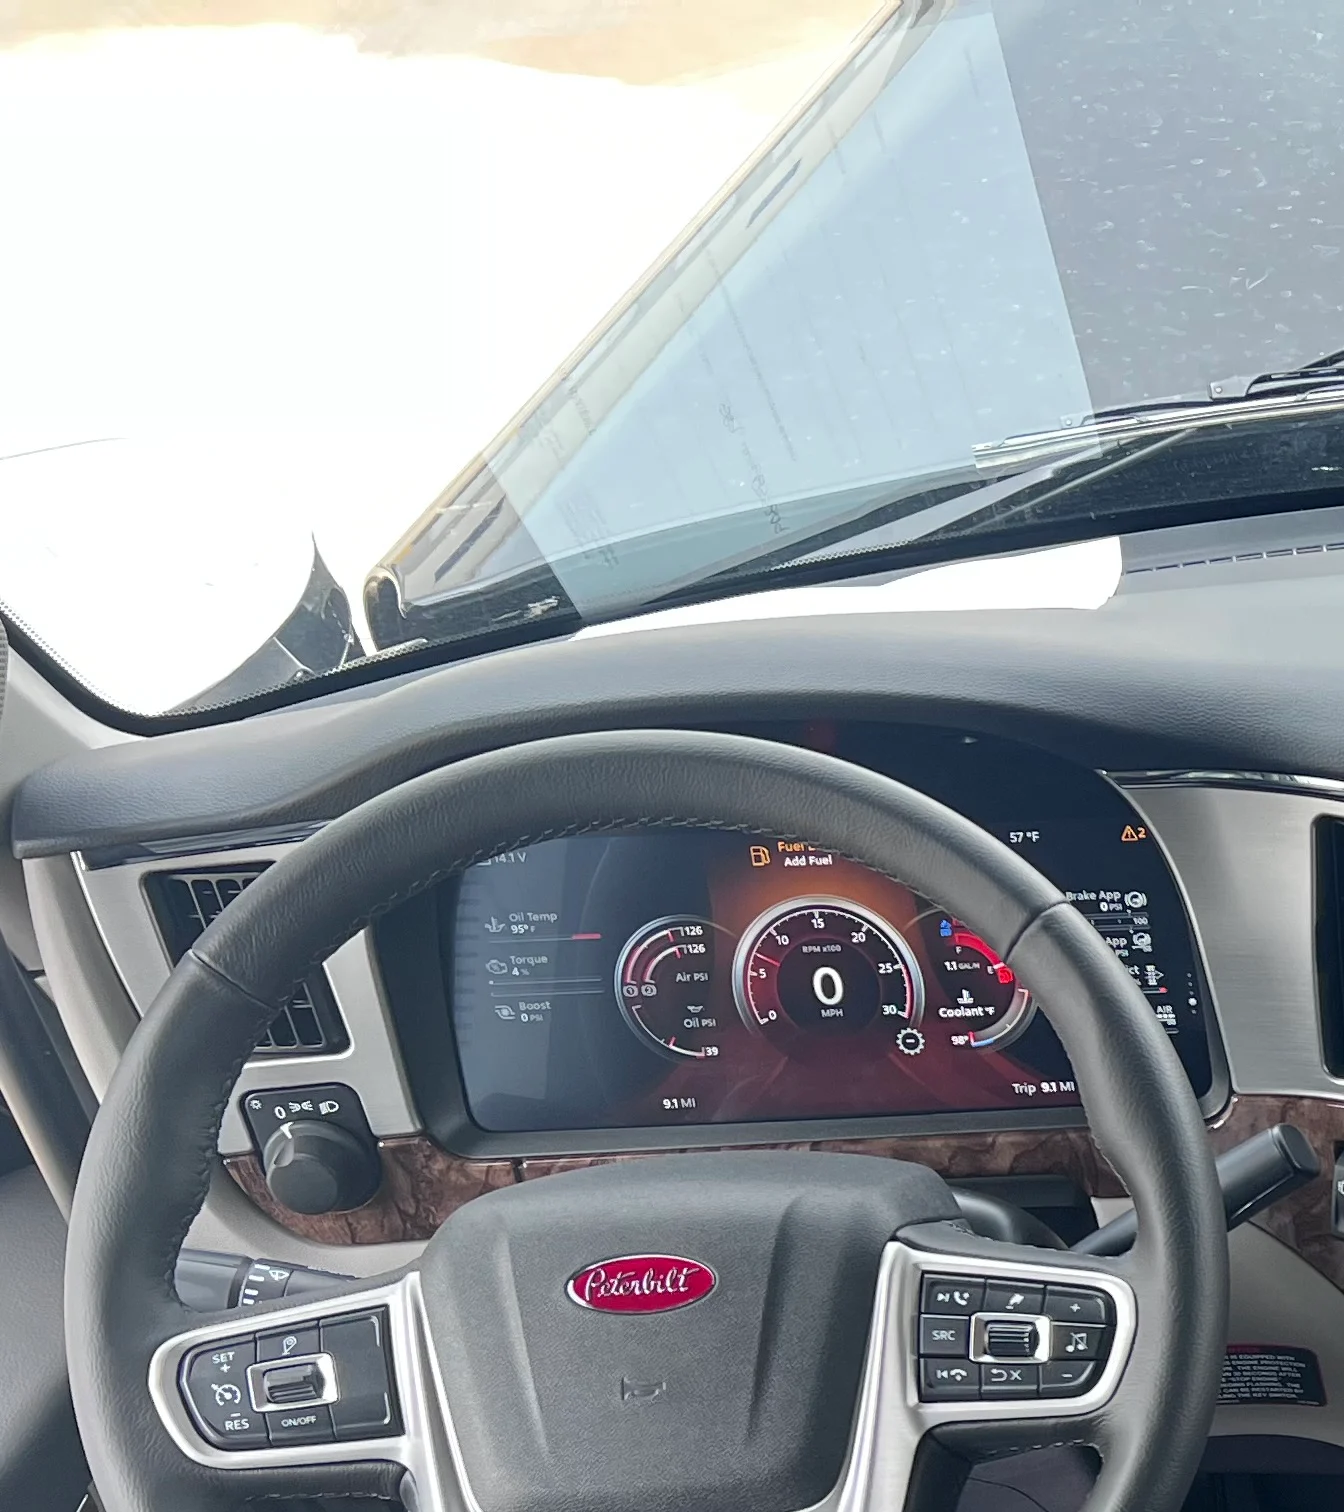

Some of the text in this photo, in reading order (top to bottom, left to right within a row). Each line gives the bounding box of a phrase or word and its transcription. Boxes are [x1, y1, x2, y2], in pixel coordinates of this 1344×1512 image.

[1009, 831, 1024, 843] 57
[1137, 827, 1147, 839] 2
[517, 852, 527, 863] V
[784, 854, 833, 867] Add Fuel
[1065, 889, 1122, 901] Brake App
[1100, 902, 1108, 911] 0
[509, 912, 558, 923] Oil Temp
[811, 919, 825, 929] 15
[776, 935, 790, 946] 10
[851, 932, 867, 943] 20
[1105, 937, 1128, 948] App
[509, 955, 548, 966] Torque
[511, 967, 520, 976] 4
[759, 968, 767, 978] 5
[878, 963, 893, 974] 25
[675, 971, 708, 982] Air PSI
[812, 966, 844, 1006] 0
[519, 1001, 552, 1011] Boost
[882, 1004, 897, 1015] 30
[520, 1012, 529, 1022] 0
[768, 1010, 777, 1021] 0
[821, 1008, 844, 1018] MPH
[938, 1006, 985, 1018] Coolant
[683, 1018, 717, 1028] Oil PSI
[1012, 1081, 1076, 1096] Trip 9.1 MI
[662, 1098, 696, 1109] 9.1 MI
[584, 1266, 700, 1301] Peterbilt
[931, 1329, 956, 1341] SRC
[211, 1351, 236, 1364] SET
[224, 1418, 250, 1431] RES
[280, 1415, 317, 1428] ON/OFF
